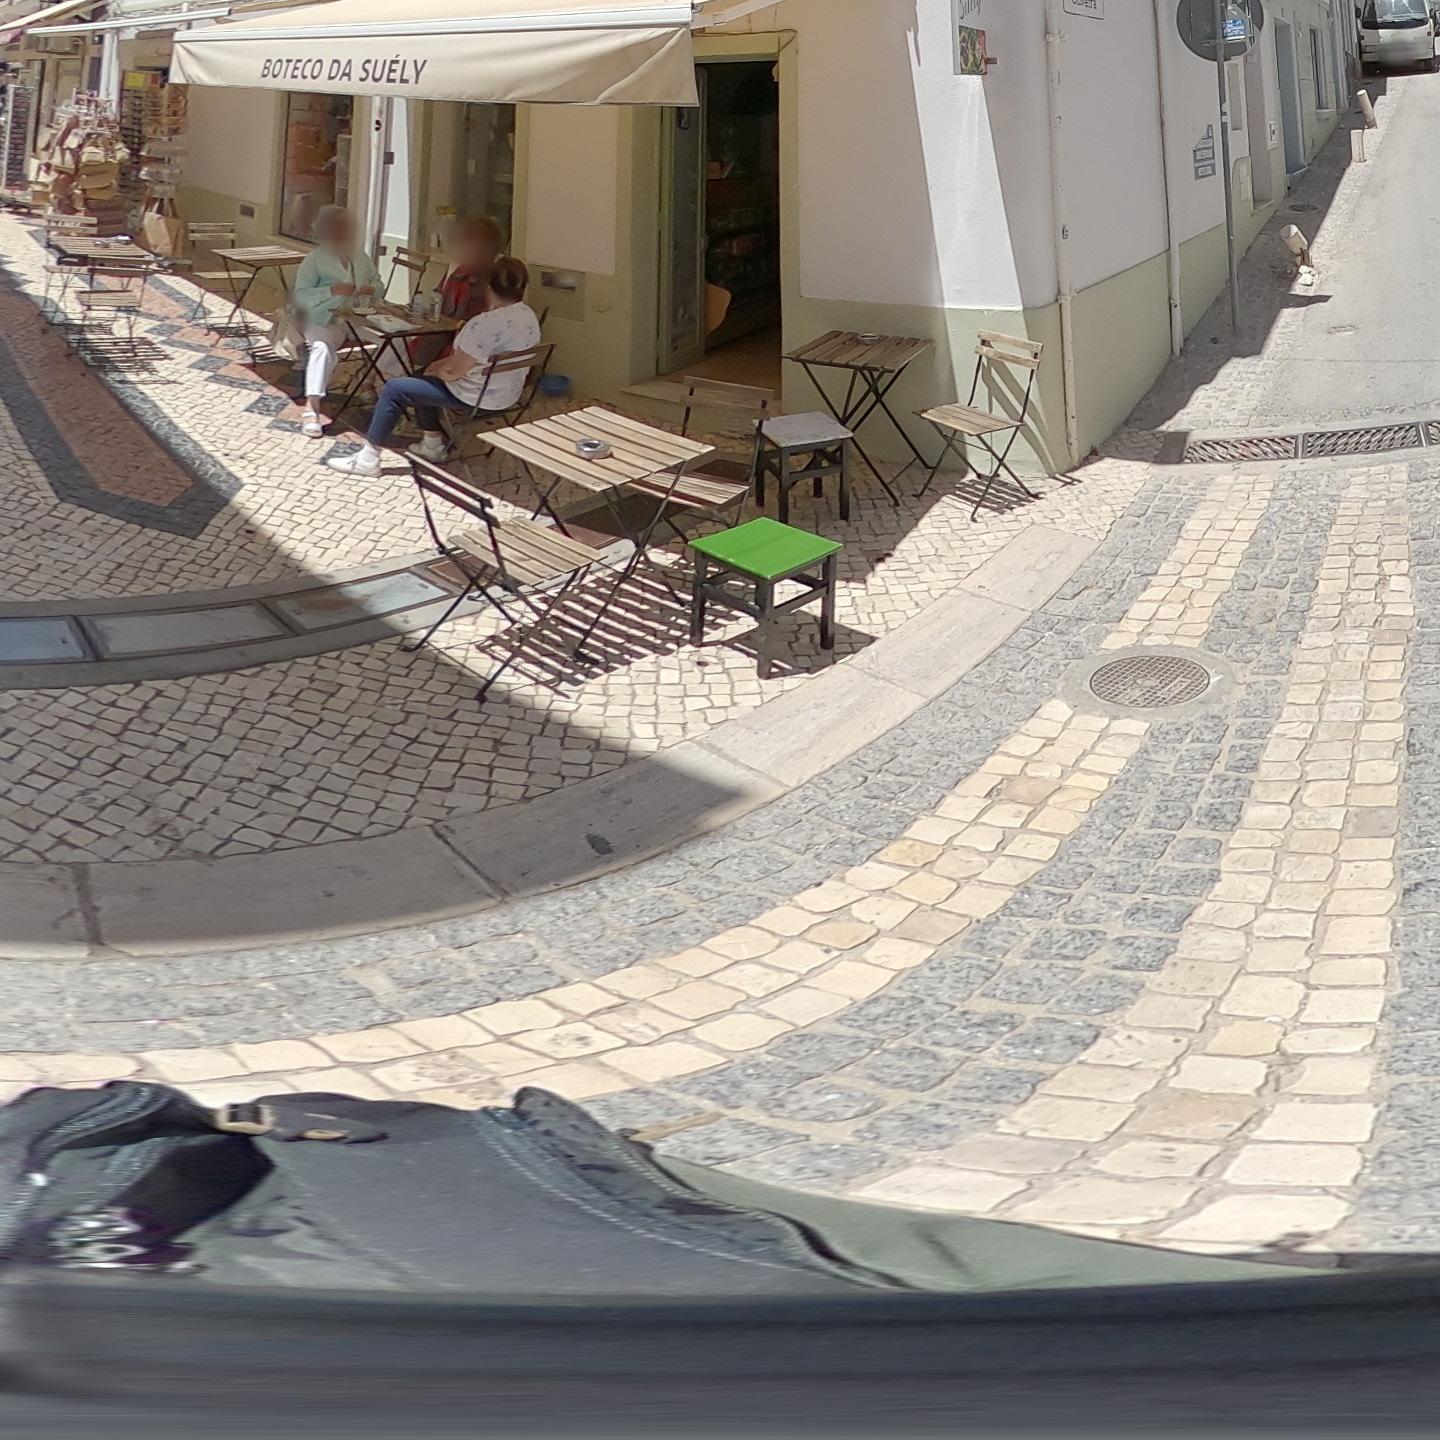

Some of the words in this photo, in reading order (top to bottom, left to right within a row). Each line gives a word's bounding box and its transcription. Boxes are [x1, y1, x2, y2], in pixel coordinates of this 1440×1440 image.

[261, 58, 324, 80] BOTECO
[327, 59, 353, 82] DA
[359, 54, 428, 85] SUÉLY
